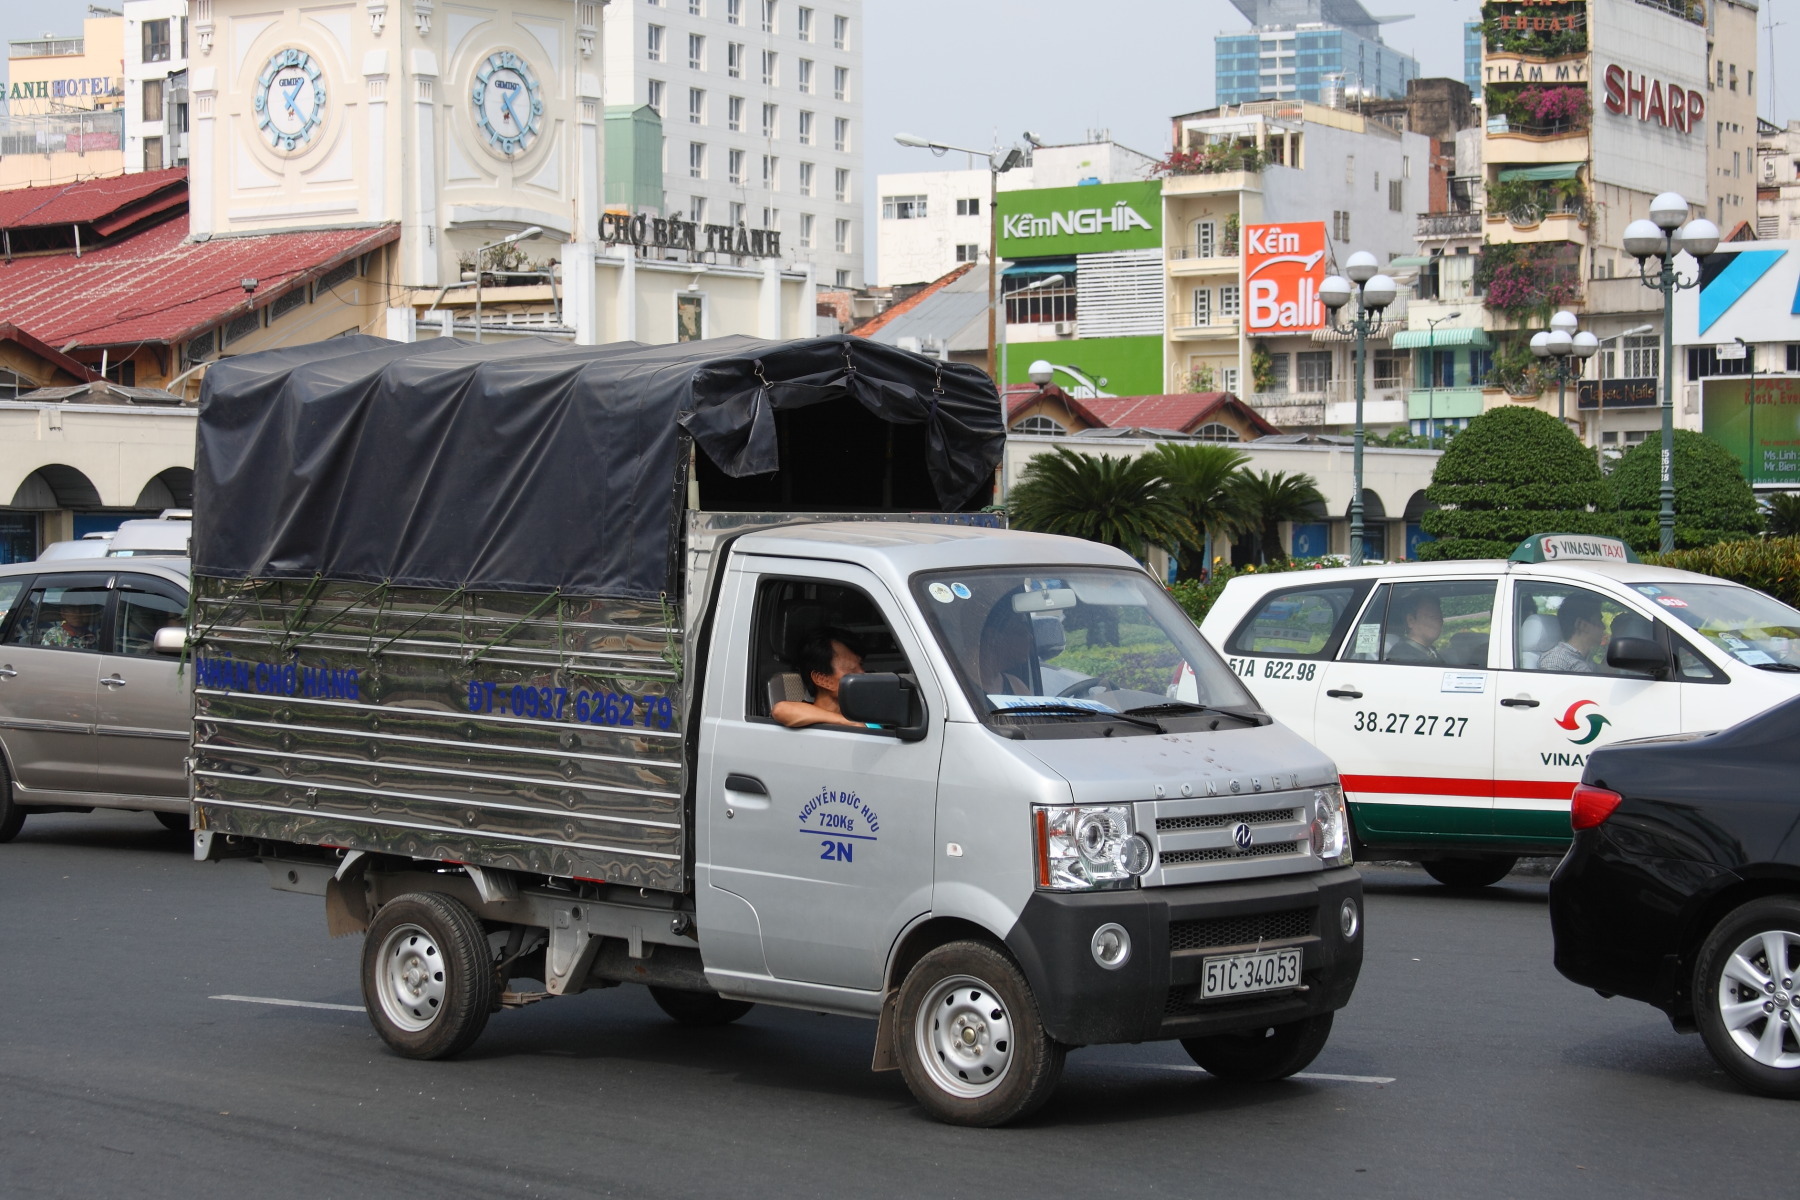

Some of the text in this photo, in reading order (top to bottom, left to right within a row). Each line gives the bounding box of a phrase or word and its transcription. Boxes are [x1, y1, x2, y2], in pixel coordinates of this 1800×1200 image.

[282, 49, 298, 66] 12
[501, 52, 517, 68] 12
[9, 81, 48, 99] ANH
[52, 77, 113, 97] HOTEL
[473, 88, 484, 105] 9
[1603, 64, 1704, 135] SHARP
[255, 95, 264, 111] 9
[284, 136, 295, 151] 6
[503, 139, 514, 155] 6
[652, 210, 697, 250] BẾN
[704, 220, 781, 257] THÀNH
[1248, 227, 1300, 254] Kềm
[1248, 277, 1321, 328] Balli
[1560, 541, 1624, 558] VINASUN TAXI
[196, 651, 249, 696] NHẬN
[304, 659, 359, 700] HÀNG
[1229, 658, 1316, 681] 51A 622.98
[576, 690, 634, 726] 6262
[645, 696, 673, 729] 79
[1354, 711, 1469, 737] 38.27 27 27
[1540, 753, 1590, 767] VINA
[1153, 773, 1300, 798] DONGBEN
[799, 786, 836, 823] NGUYỄN
[840, 791, 860, 809] ĐỨC
[820, 813, 854, 831] 720Kg
[820, 840, 853, 863] 2N
